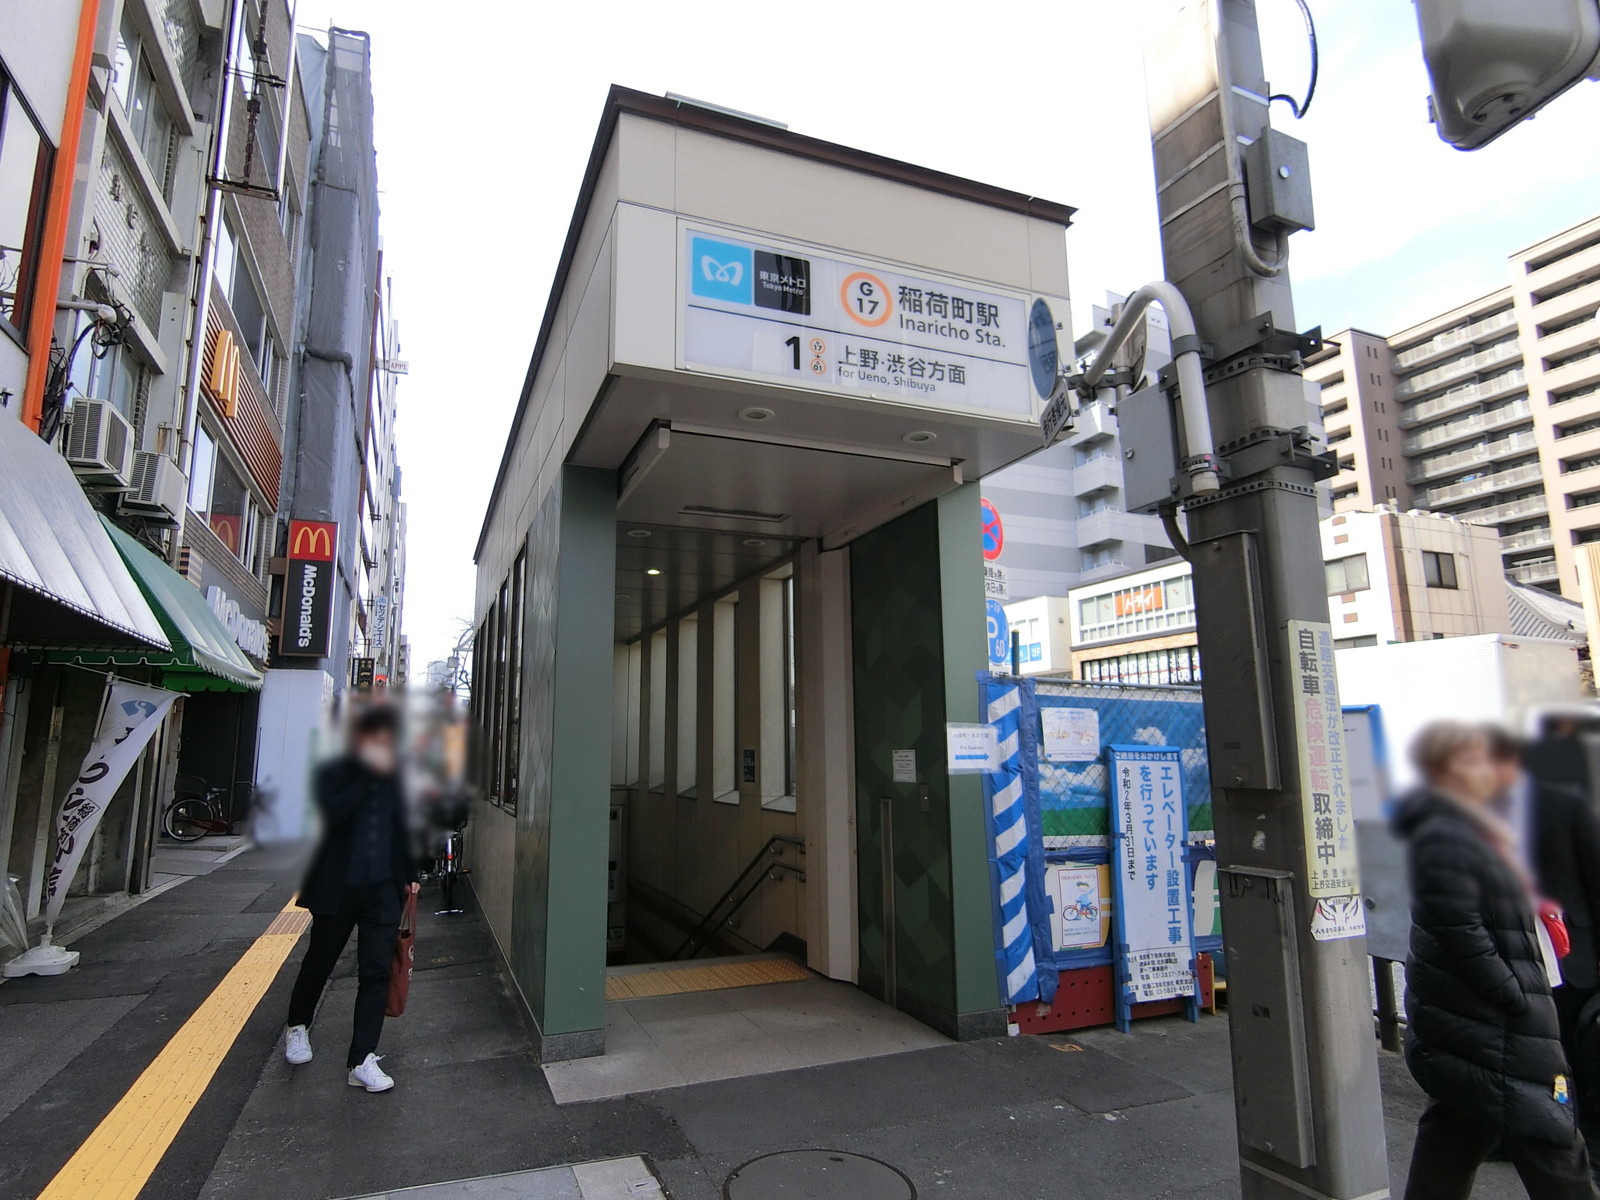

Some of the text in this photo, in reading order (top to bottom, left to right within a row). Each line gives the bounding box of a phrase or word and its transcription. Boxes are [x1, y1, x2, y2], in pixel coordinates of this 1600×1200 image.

[760, 270, 806, 288] 東京メトロ
[762, 281, 803, 296] Tokyo Metro
[859, 281, 873, 297] G
[857, 297, 879, 314] 17
[898, 286, 999, 329] 稲荷町駅
[900, 313, 1006, 348] Inaricho Sta.
[785, 336, 801, 370] 1
[838, 367, 936, 393] for Ueno, Shibuya
[298, 563, 318, 648] McDonald's
[1299, 628, 1336, 866] 自転車危険運転取締中
[1122, 766, 1136, 881] 令和2年3月31日まで
[1139, 765, 1159, 891] を行っています
[1160, 766, 1182, 945] エレベーター設置工事
